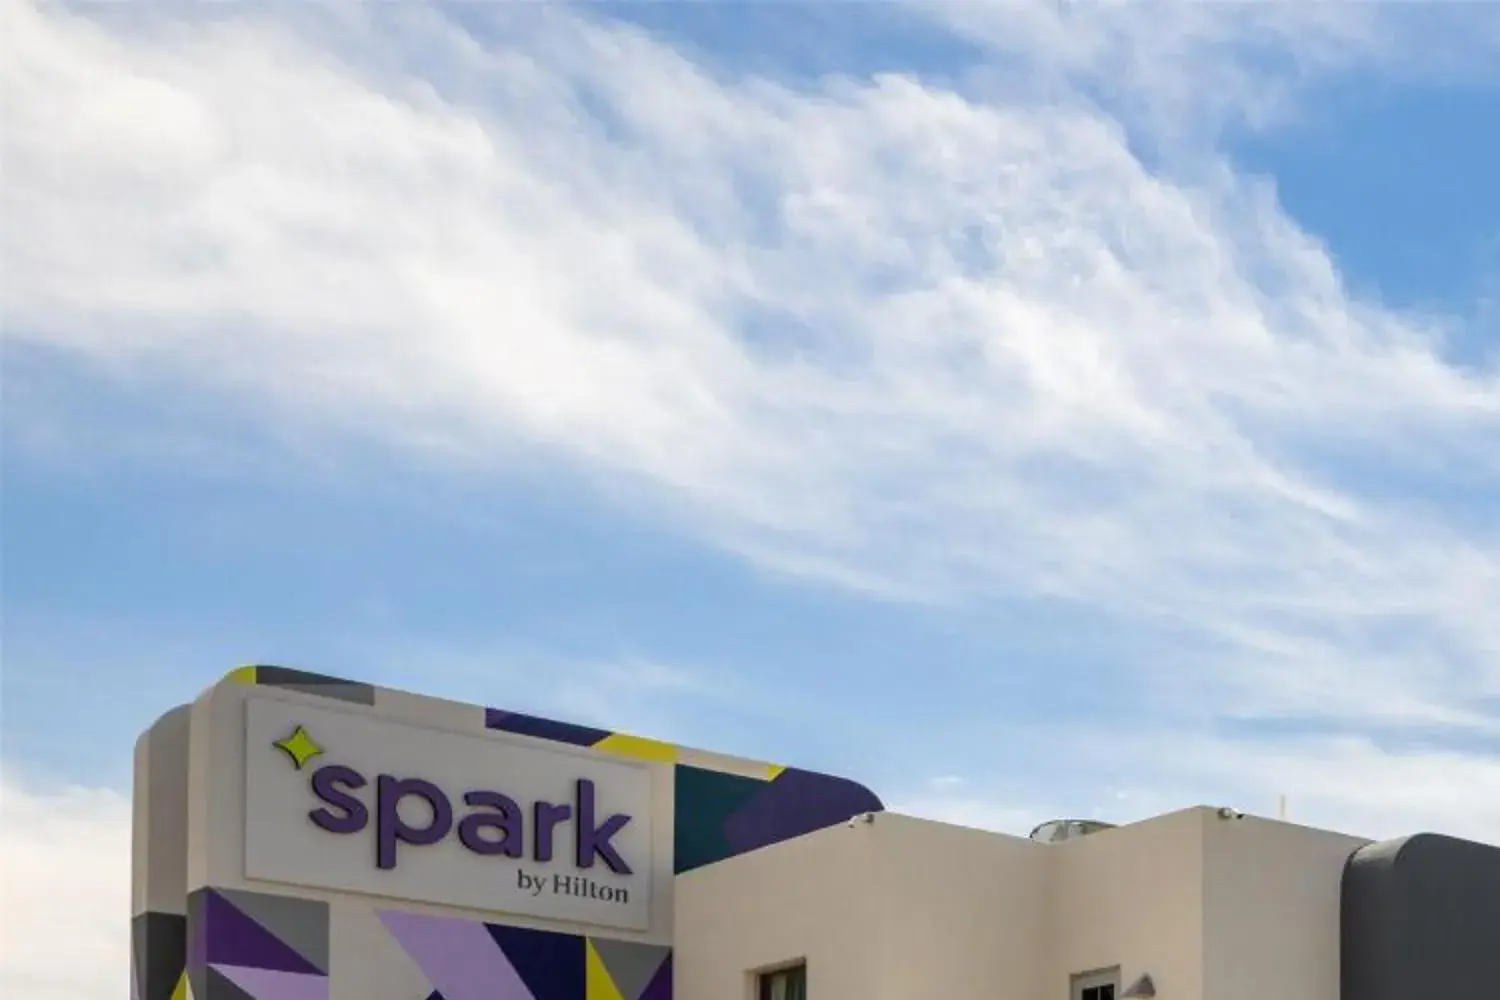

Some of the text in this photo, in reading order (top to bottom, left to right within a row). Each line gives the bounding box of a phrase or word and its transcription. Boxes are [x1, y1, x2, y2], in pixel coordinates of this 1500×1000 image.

[308, 764, 633, 874] spark
[517, 868, 629, 904] by Hilton
